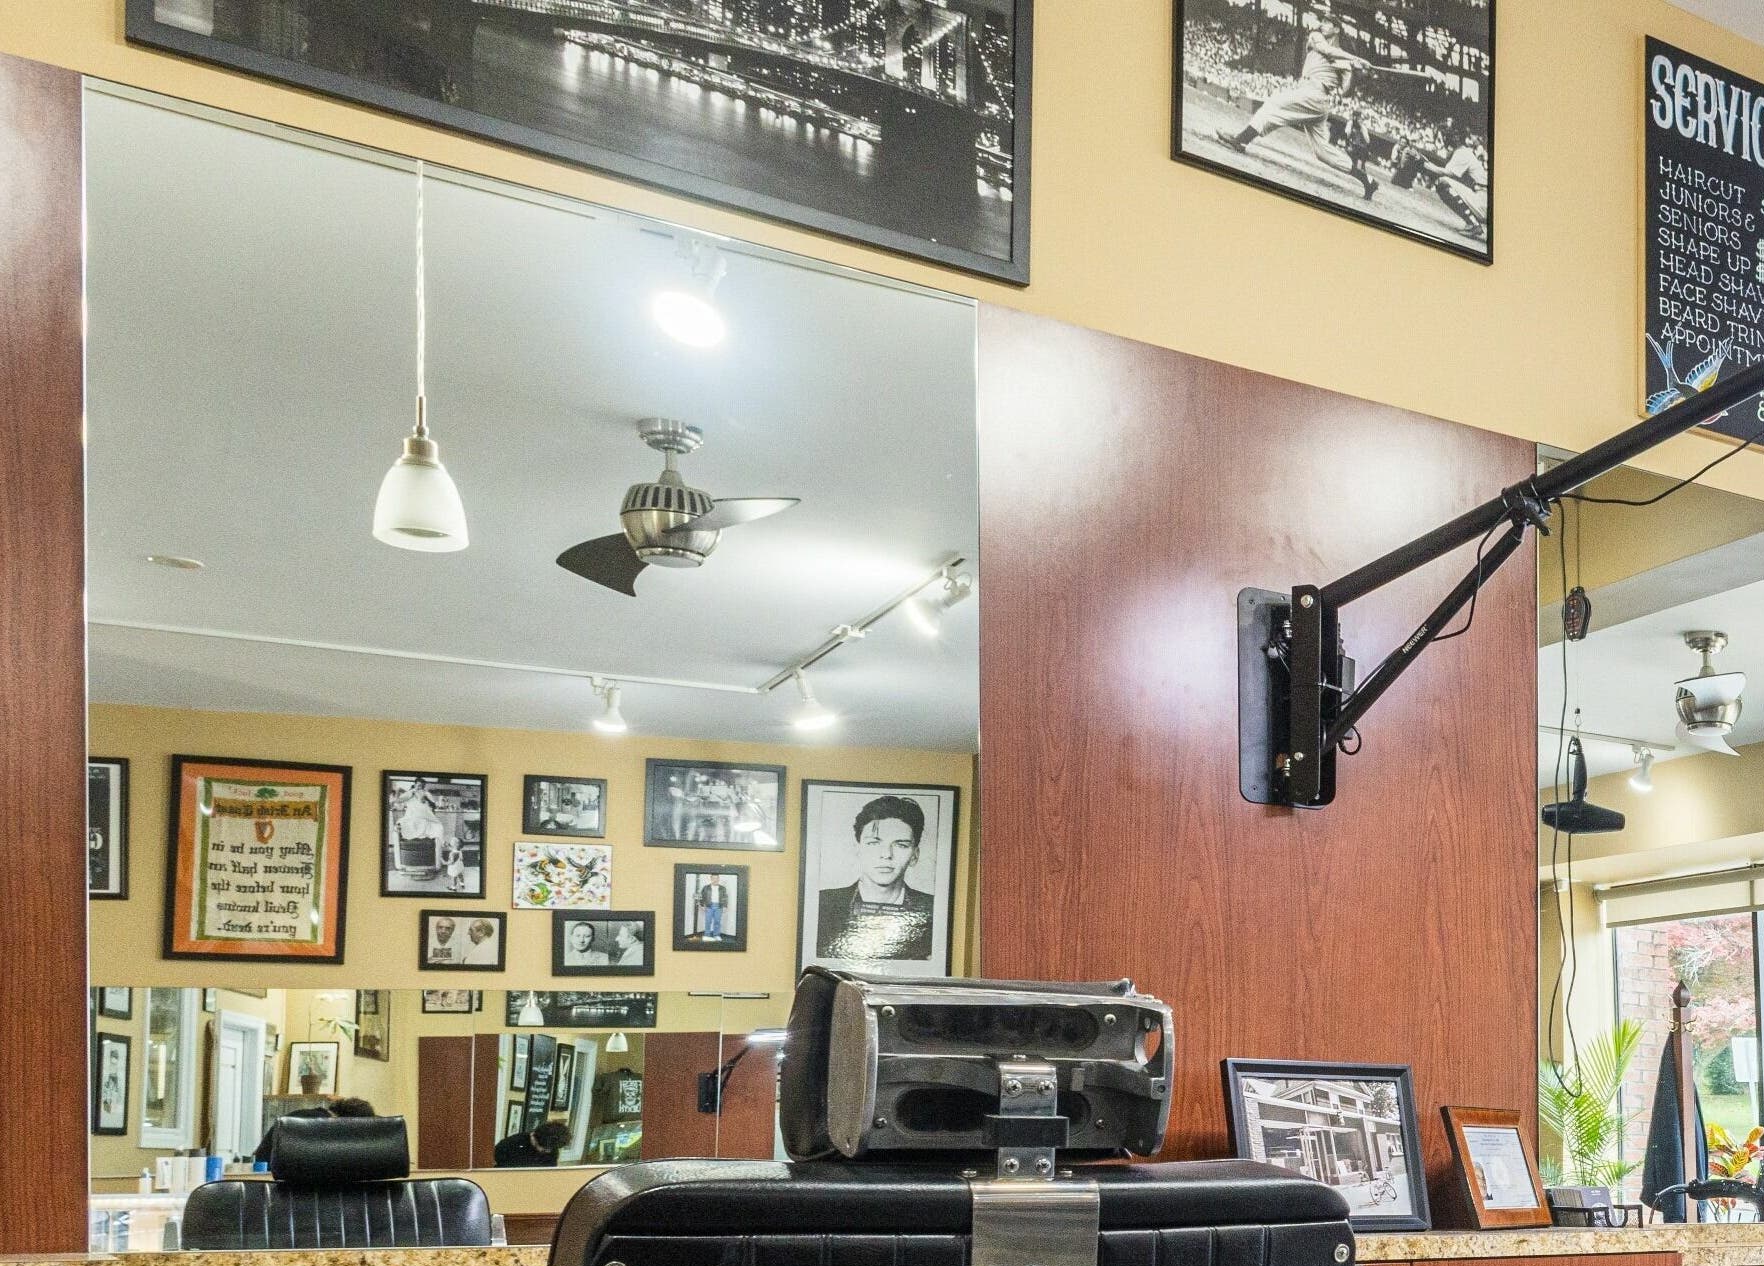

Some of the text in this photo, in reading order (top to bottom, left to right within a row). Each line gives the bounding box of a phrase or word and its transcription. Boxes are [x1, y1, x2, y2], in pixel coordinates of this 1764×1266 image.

[1659, 156, 1745, 204] HAIRCUT
[1660, 182, 1742, 227] JUNIORS
[1658, 205, 1741, 250] SENIORS
[1658, 227, 1720, 265] SHAPE
[1727, 251, 1750, 274] UP
[1659, 250, 1713, 284] HEAD
[1659, 274, 1706, 305] FACE
[1659, 297, 1720, 332] BEARD
